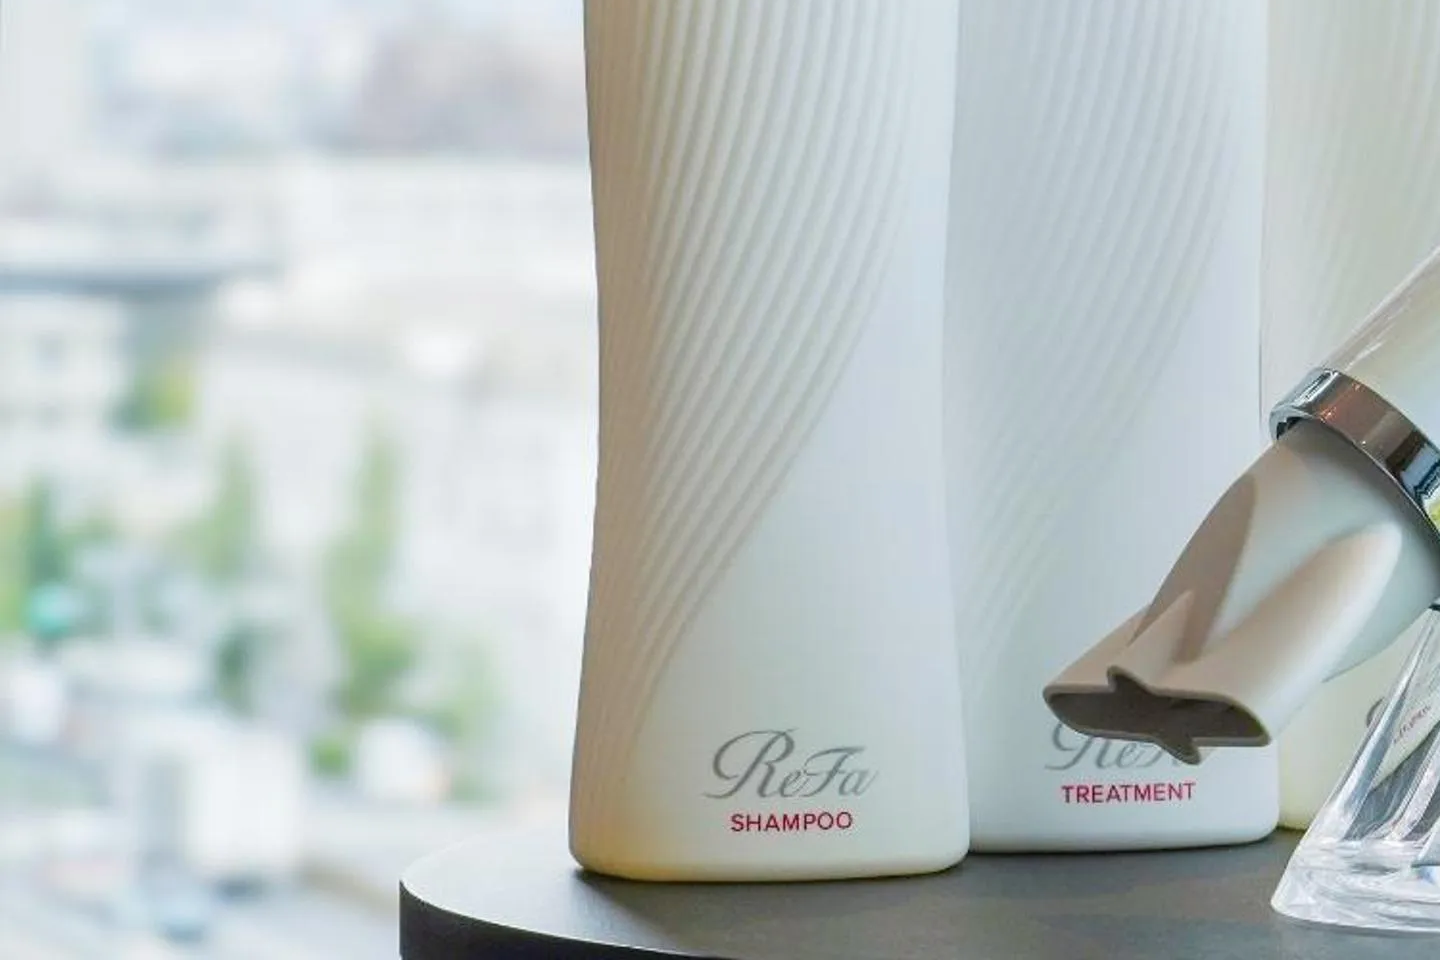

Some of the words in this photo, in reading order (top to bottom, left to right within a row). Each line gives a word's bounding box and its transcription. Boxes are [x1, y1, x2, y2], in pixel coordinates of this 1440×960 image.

[702, 726, 878, 800] ReFa
[1062, 782, 1196, 803] TREATMENT
[730, 811, 853, 832] SHAMPOO
